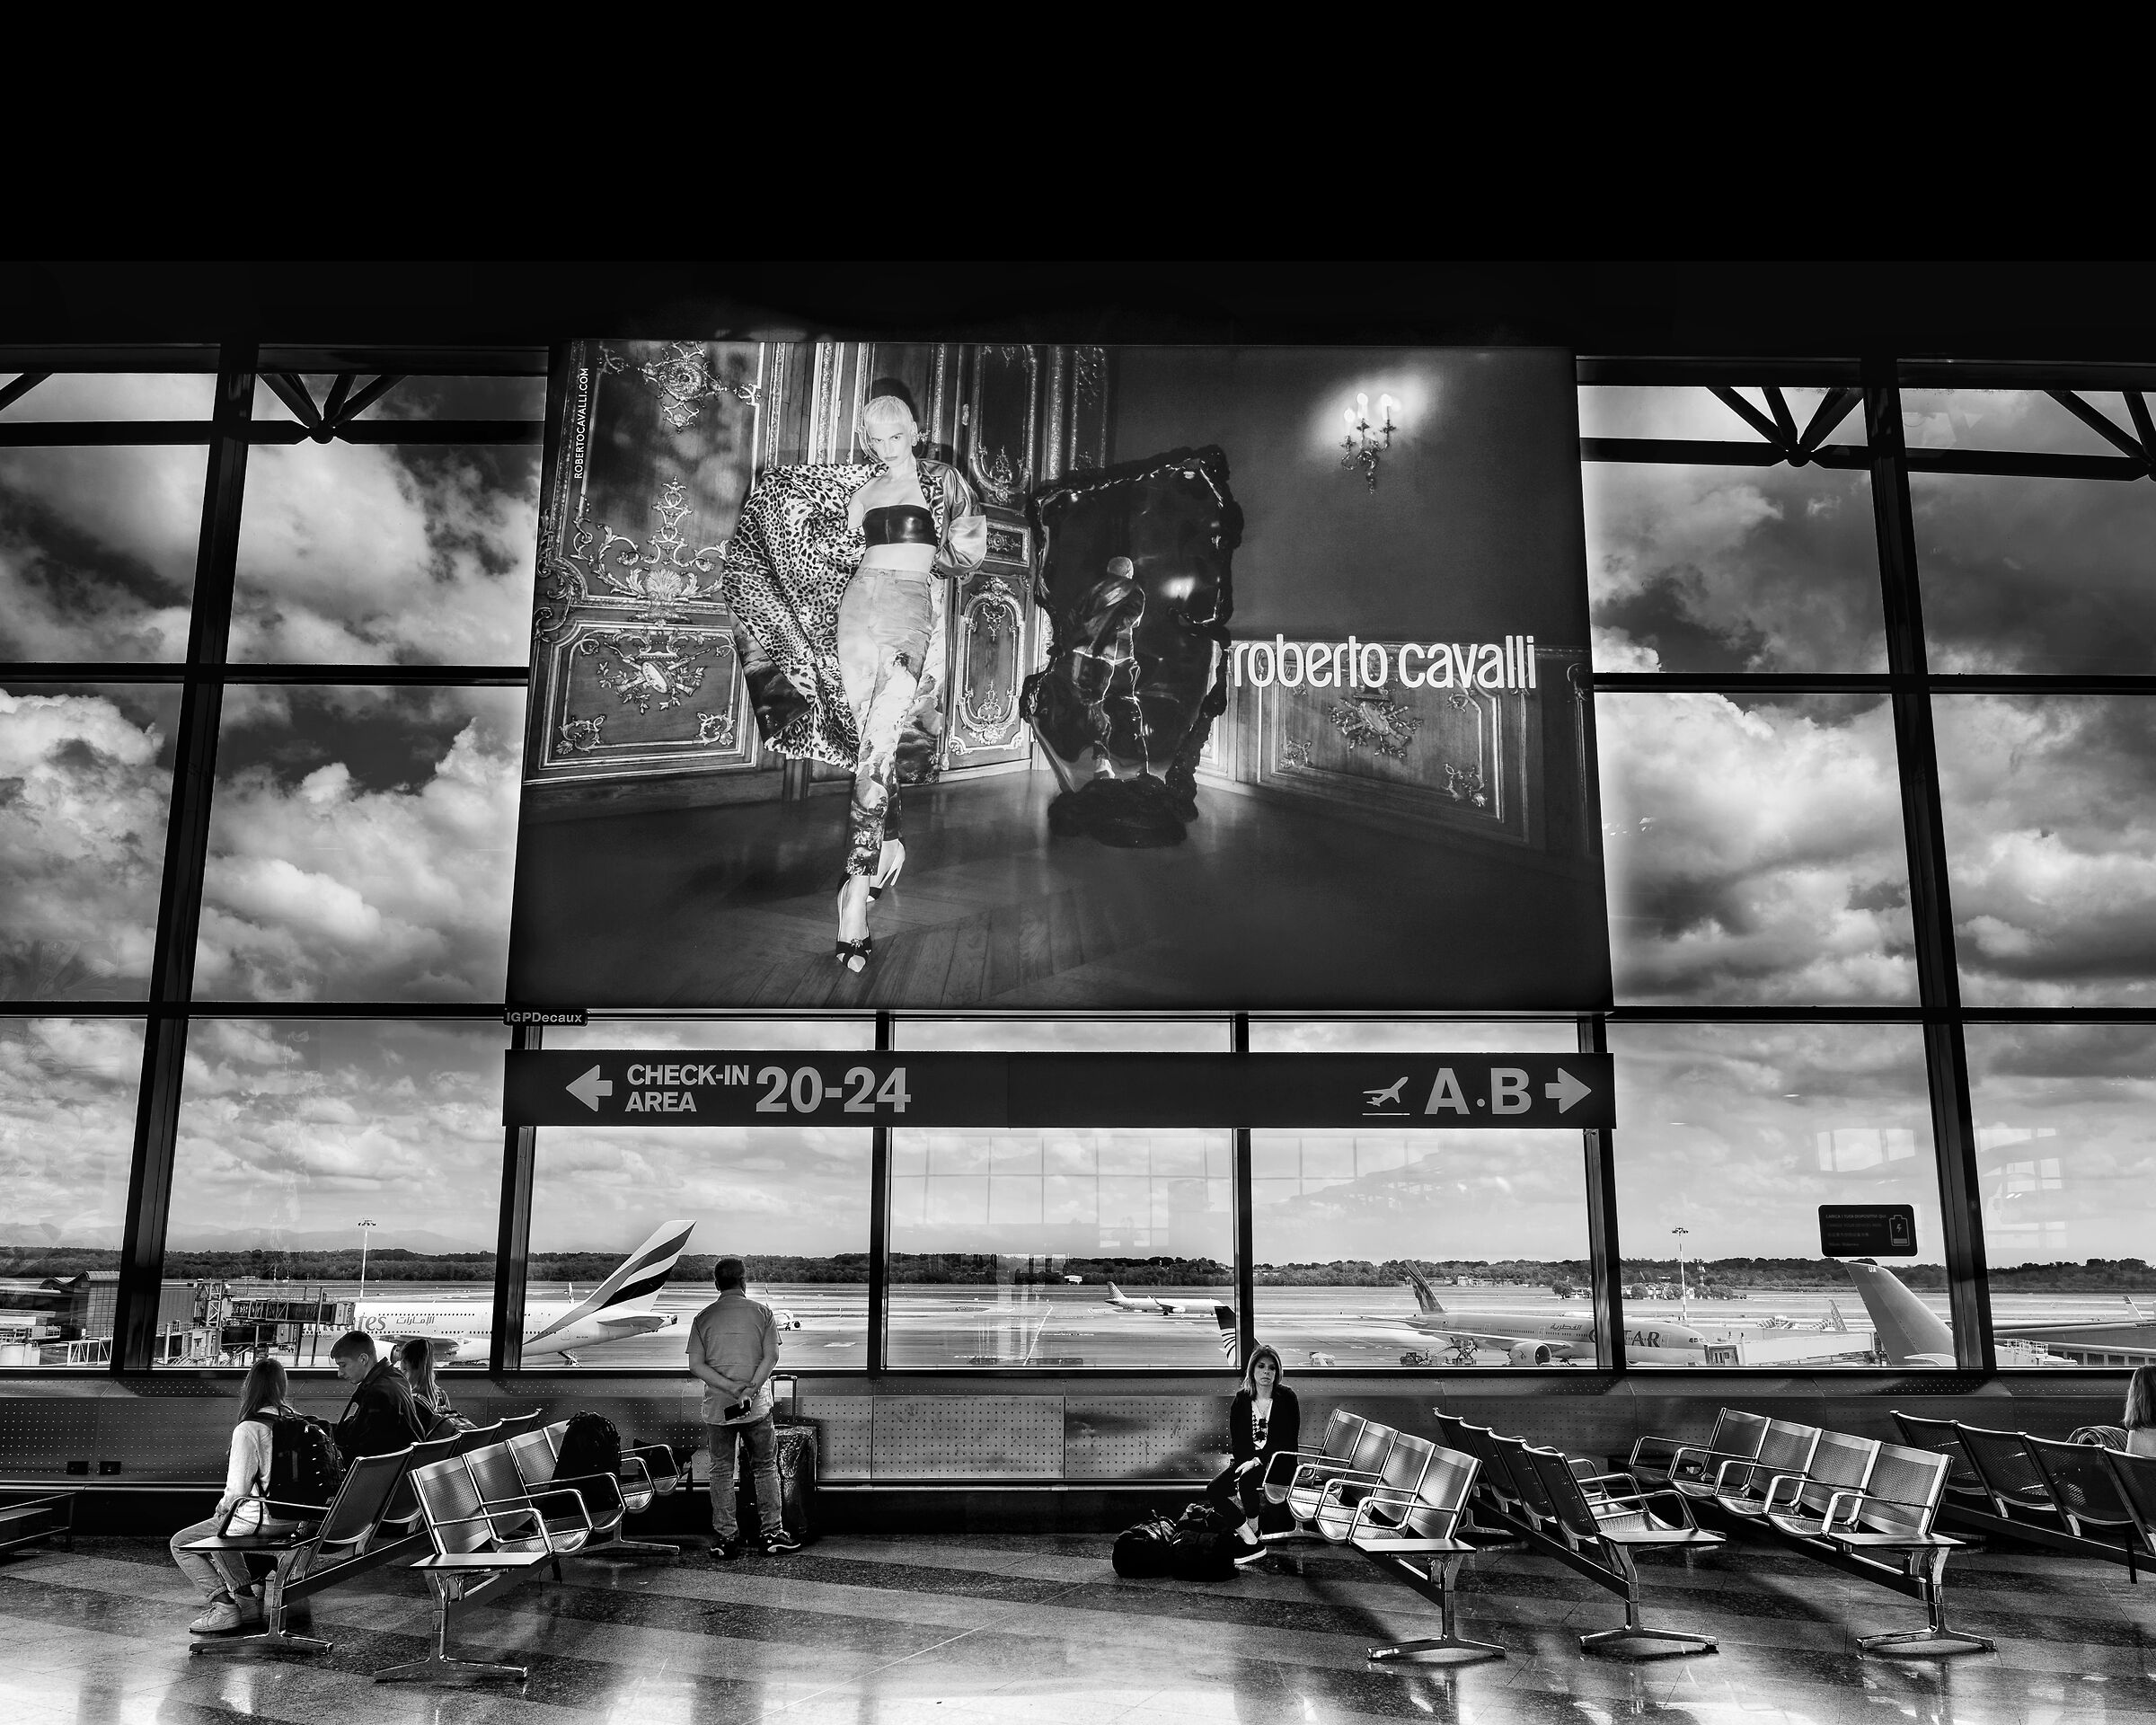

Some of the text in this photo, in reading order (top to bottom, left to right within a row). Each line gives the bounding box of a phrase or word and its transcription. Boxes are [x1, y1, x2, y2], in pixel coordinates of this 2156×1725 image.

[574, 367, 589, 479] ROBERTOCAVALLI.COM
[1233, 633, 1537, 689] roberto cavalli
[506, 1012, 582, 1022] IGPDecaux
[627, 1065, 749, 1085] CHECK-IN
[755, 1066, 912, 1113] 20-24
[625, 1092, 697, 1112] AREA
